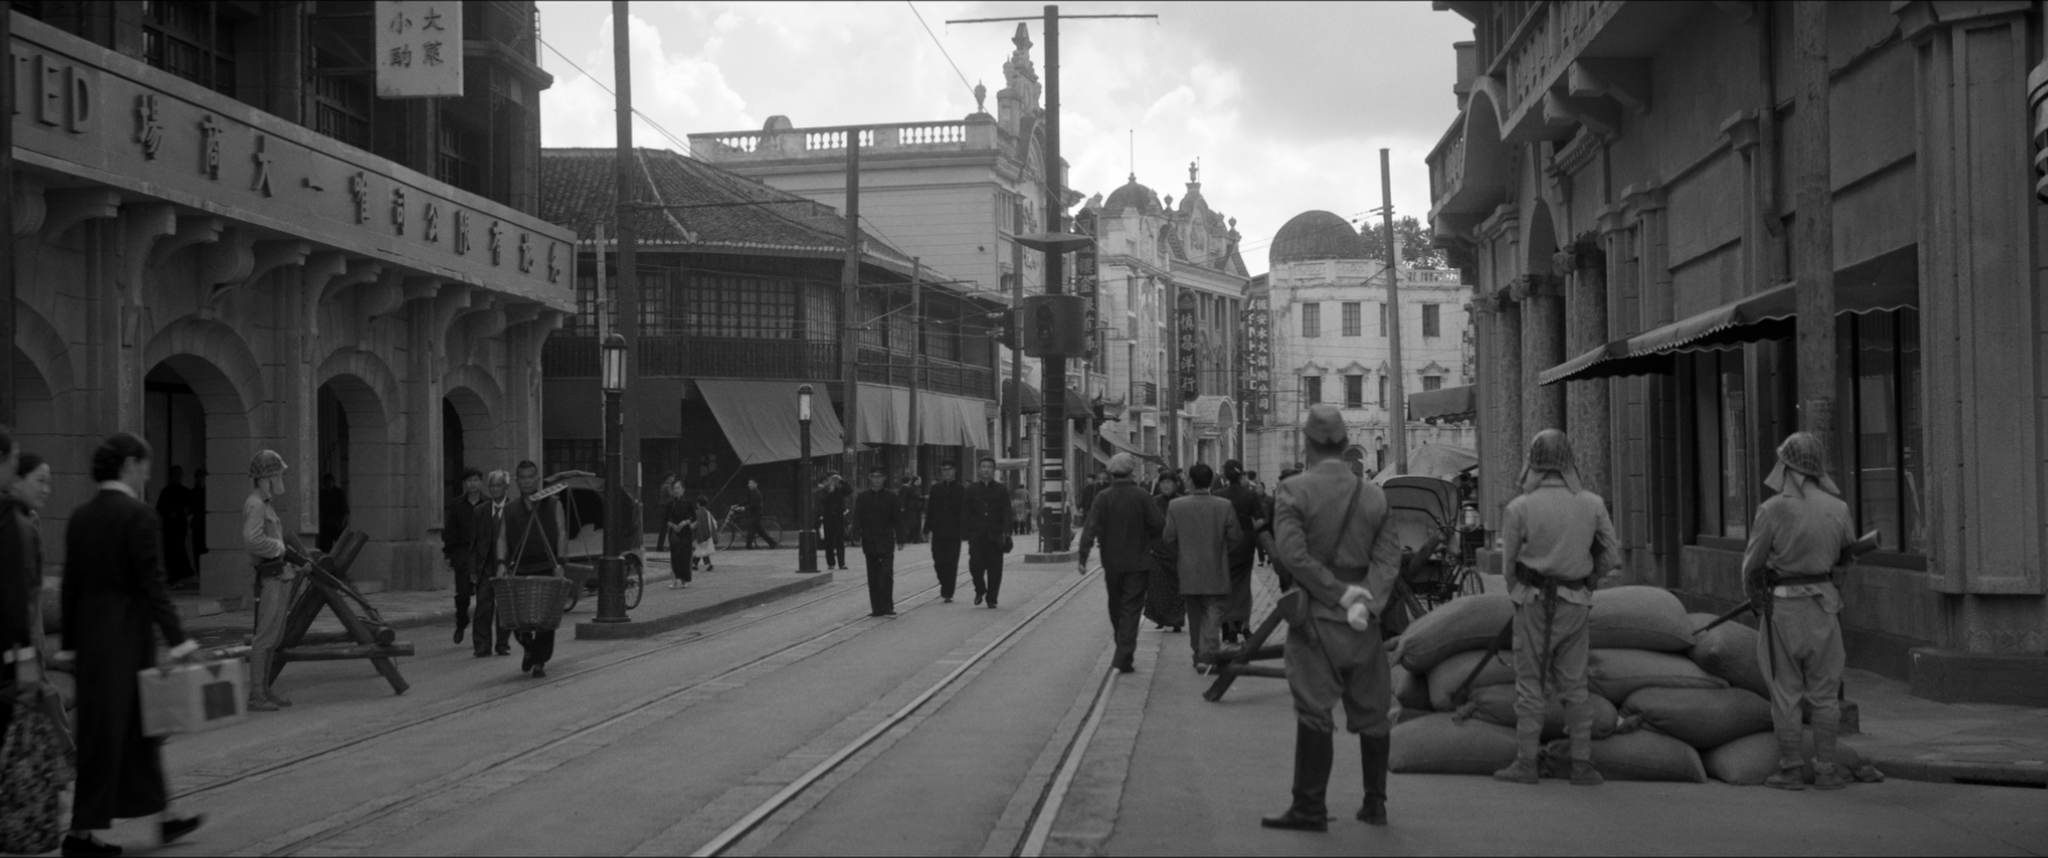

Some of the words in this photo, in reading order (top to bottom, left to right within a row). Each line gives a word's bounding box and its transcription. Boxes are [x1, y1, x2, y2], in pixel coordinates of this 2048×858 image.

[422, 6, 445, 67] 大菜
[1179, 312, 1195, 393] 慎昌洋行
